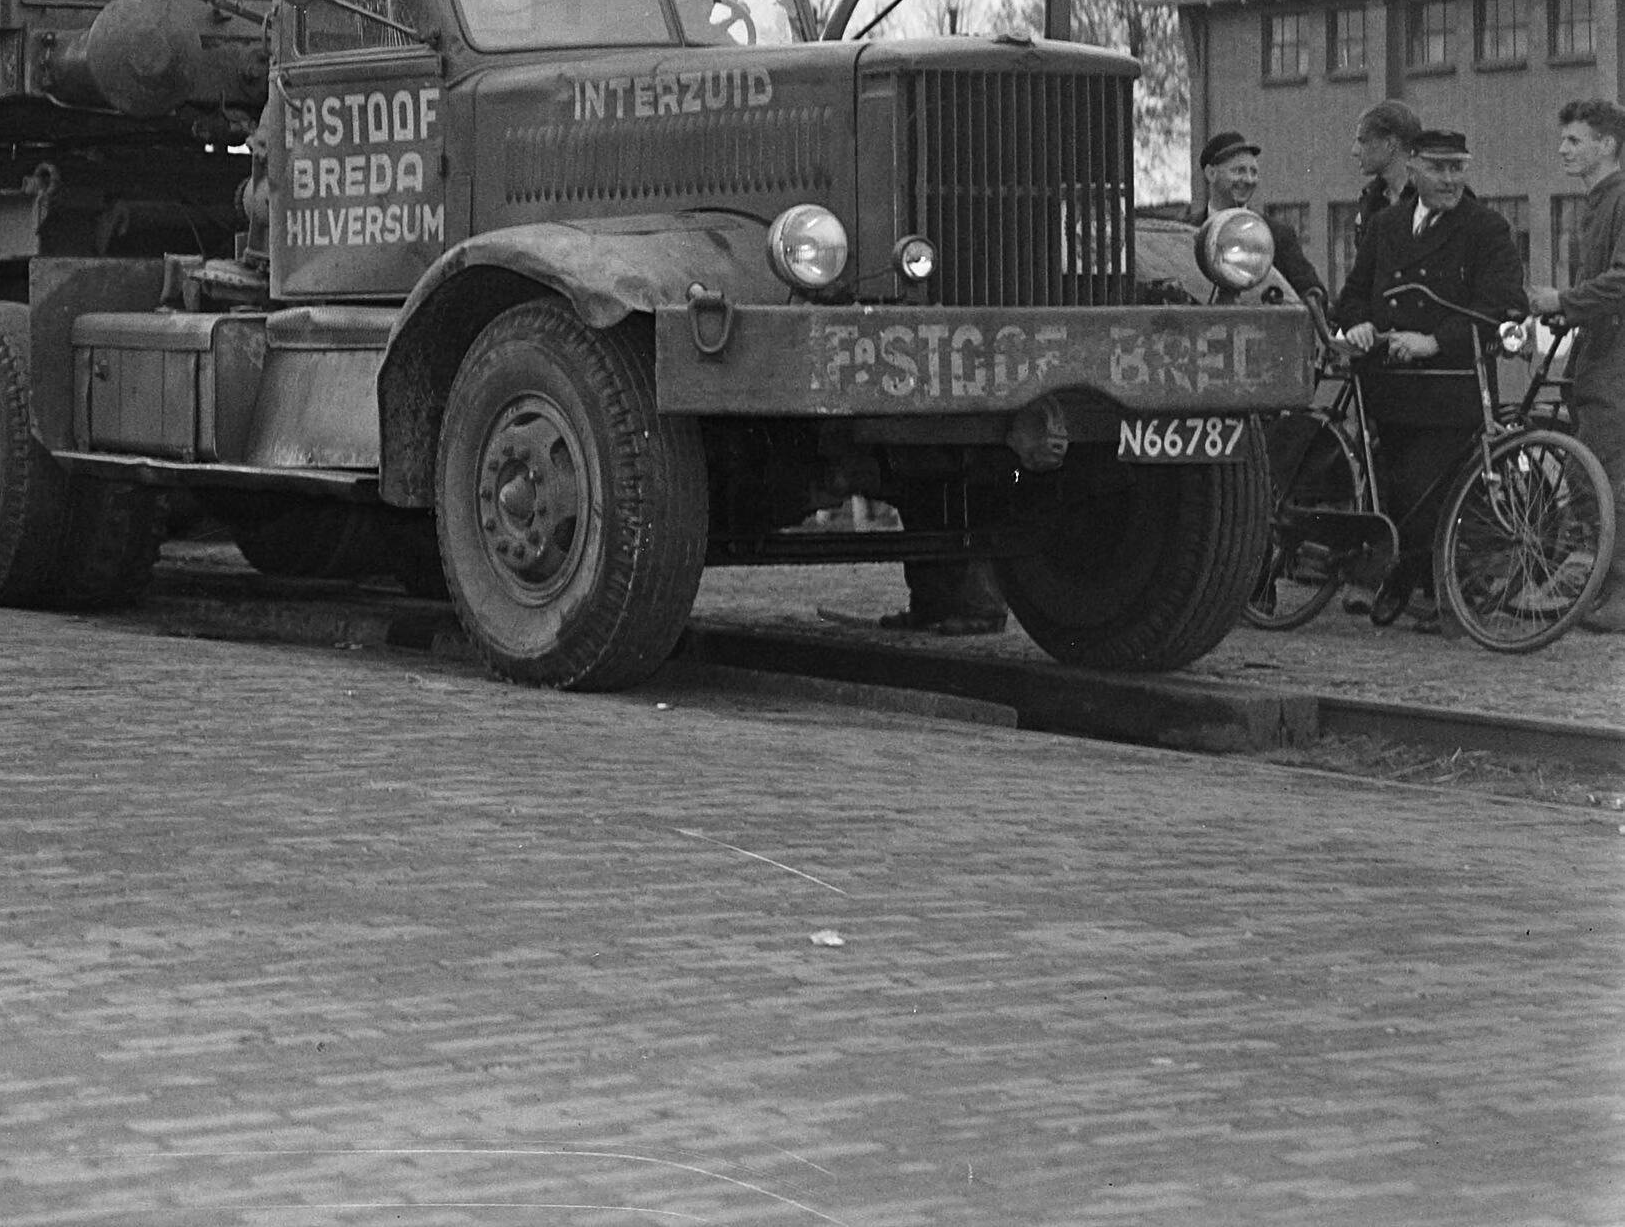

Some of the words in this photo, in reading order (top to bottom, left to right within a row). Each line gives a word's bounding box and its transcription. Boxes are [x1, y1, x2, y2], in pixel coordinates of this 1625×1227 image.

[574, 68, 773, 121] INTERZUID
[293, 151, 423, 199] BREDA
[286, 203, 445, 247] HILVERSUM
[1117, 417, 1244, 458] N66787
